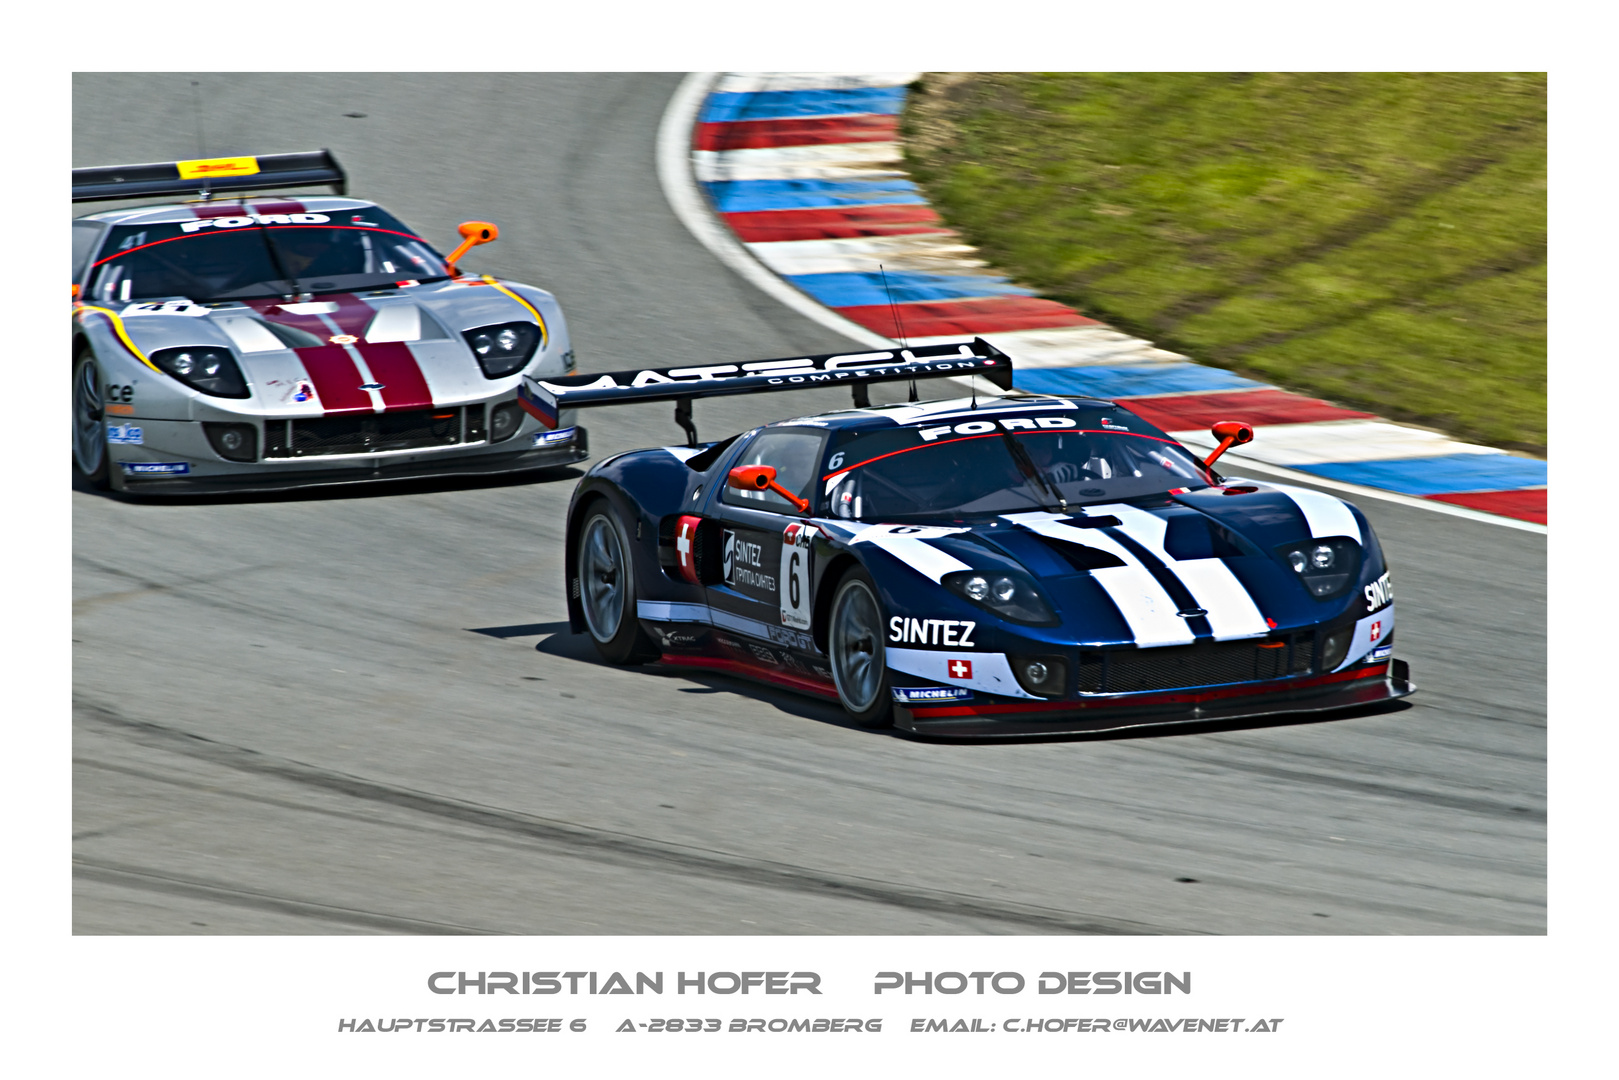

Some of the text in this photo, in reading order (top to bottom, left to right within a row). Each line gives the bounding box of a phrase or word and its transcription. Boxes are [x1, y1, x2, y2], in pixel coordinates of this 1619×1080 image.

[180, 213, 331, 233] FORD
[118, 231, 148, 250] 41
[767, 360, 976, 385] COMPETITION
[918, 417, 1077, 442] FORD
[828, 451, 846, 470] 6
[735, 540, 762, 568] SINTEZ
[788, 551, 800, 610] 6
[888, 616, 977, 647] SINTEZ
[909, 688, 968, 699] MICHELIN
